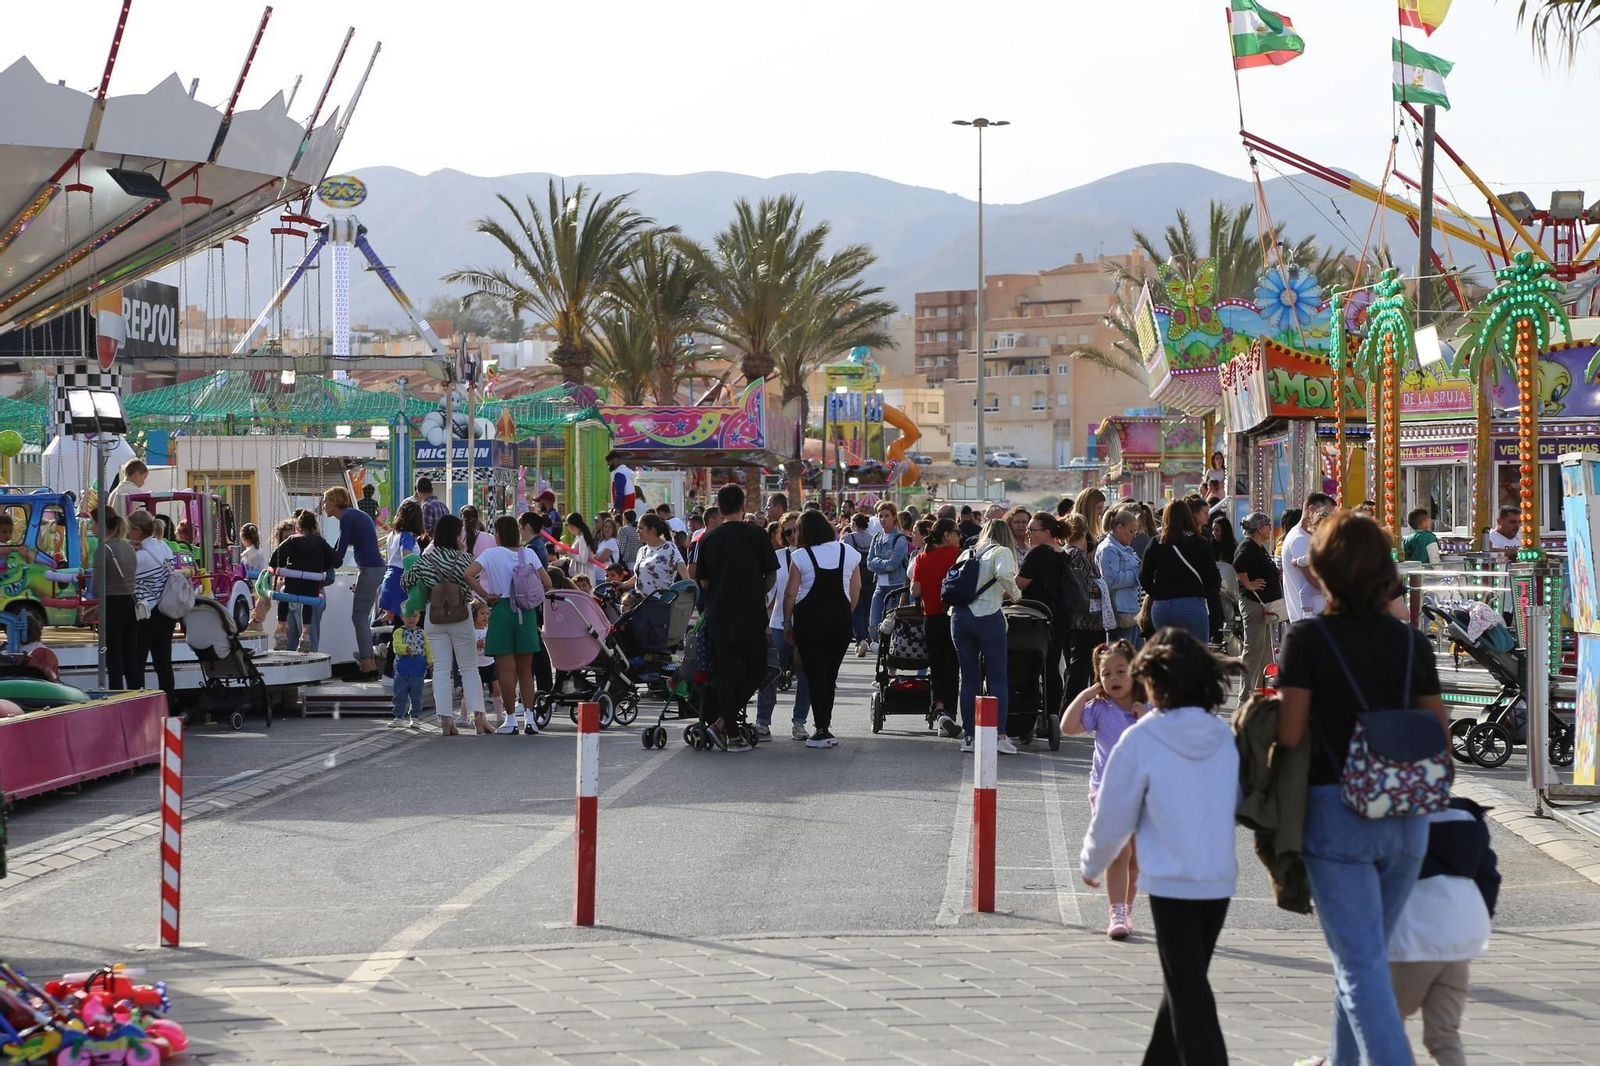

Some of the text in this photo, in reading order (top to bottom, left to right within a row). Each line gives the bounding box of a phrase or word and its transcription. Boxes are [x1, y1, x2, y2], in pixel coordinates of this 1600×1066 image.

[123, 296, 177, 347] REPSOL
[1403, 390, 1466, 405] DE LA BRUJA
[1400, 445, 1455, 459] NTA DE FICHAS
[1500, 443, 1599, 456] VEN DE FICHAS
